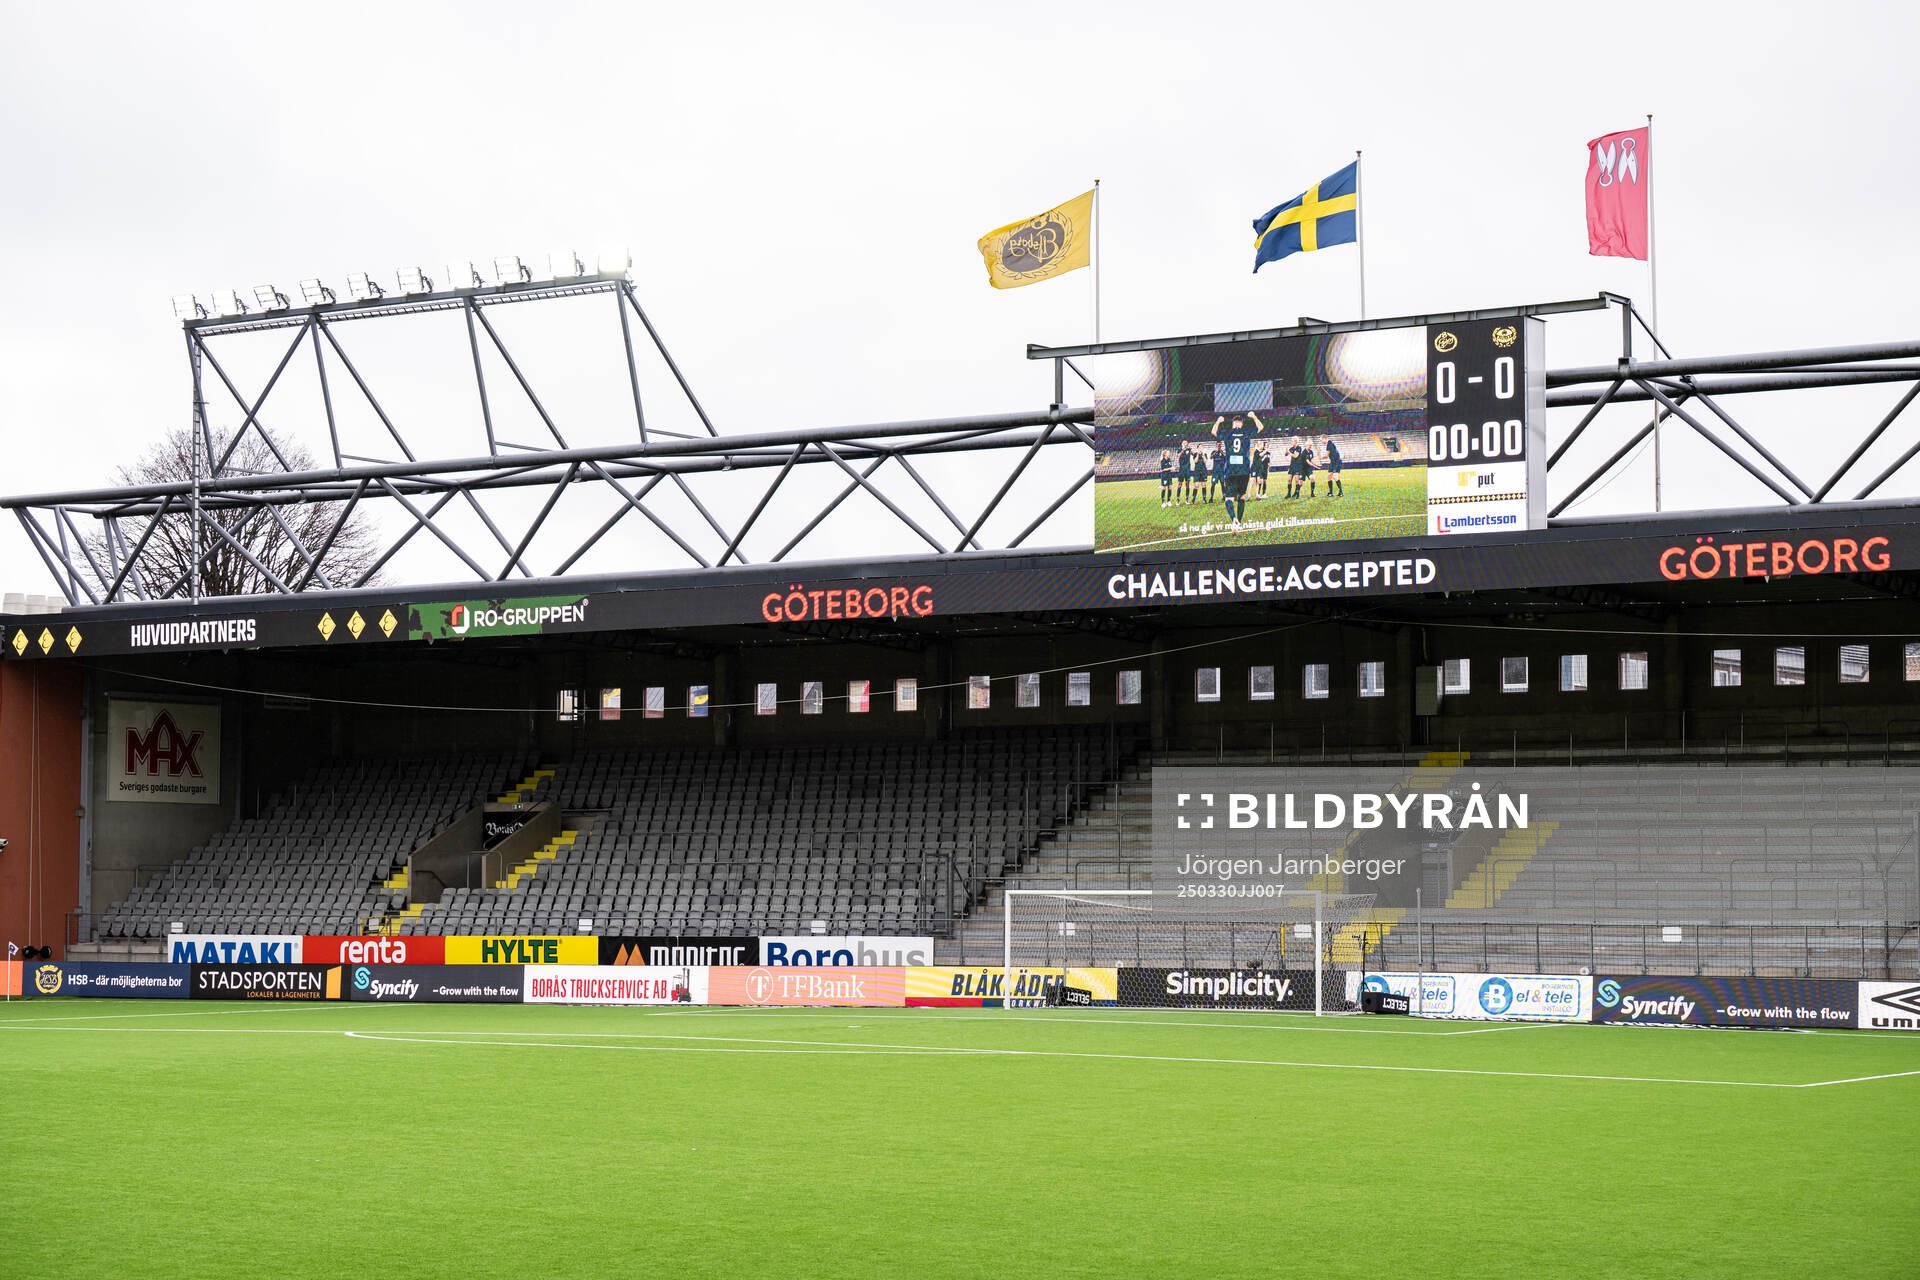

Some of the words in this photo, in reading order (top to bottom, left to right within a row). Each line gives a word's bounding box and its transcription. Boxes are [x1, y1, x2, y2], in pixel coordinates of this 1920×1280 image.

[1436, 361, 1456, 404] 0
[1494, 356, 1514, 400] 0
[1233, 438, 1242, 453] 9
[1477, 472, 1496, 488] put
[1445, 513, 1517, 528] Lambertsson
[1659, 536, 1891, 581] GÖTEBORG
[1107, 558, 1437, 600] CHALLENGE:ACCEPTED
[761, 584, 934, 623] GÖTEBORG
[473, 604, 585, 627] RO-GRUPPEN
[131, 618, 256, 647] HUVUDPARTNERS
[125, 708, 205, 778] MAX
[119, 781, 149, 793] Sveriges
[150, 783, 179, 794] godaste
[179, 784, 208, 795] burgare
[171, 941, 292, 964] MATAKI
[340, 936, 406, 964] renta
[481, 939, 559, 964] HYLTE
[68, 974, 88, 986] HSB
[95, 975, 110, 986] där
[111, 975, 167, 989] möjligheterna
[168, 976, 183, 987] bor
[199, 971, 322, 990] STADSPORTEN
[370, 977, 419, 999] Syncify
[463, 986, 482, 996] with
[483, 986, 498, 996] the
[499, 986, 519, 996] flow
[531, 975, 567, 998] BORÅS
[570, 978, 650, 999] TRUCKSERVICE
[653, 979, 667, 999] AB
[777, 975, 865, 999] TFBank
[1382, 997, 1408, 1012] SELECT
[1421, 987, 1448, 1001] tele
[1516, 989, 1530, 1003] el
[1544, 990, 1573, 1004] tele
[1620, 995, 1696, 1021] Syncify
[1764, 1005, 1793, 1019] with
[1796, 1006, 1818, 1020] the
[1821, 1006, 1851, 1021] flow
